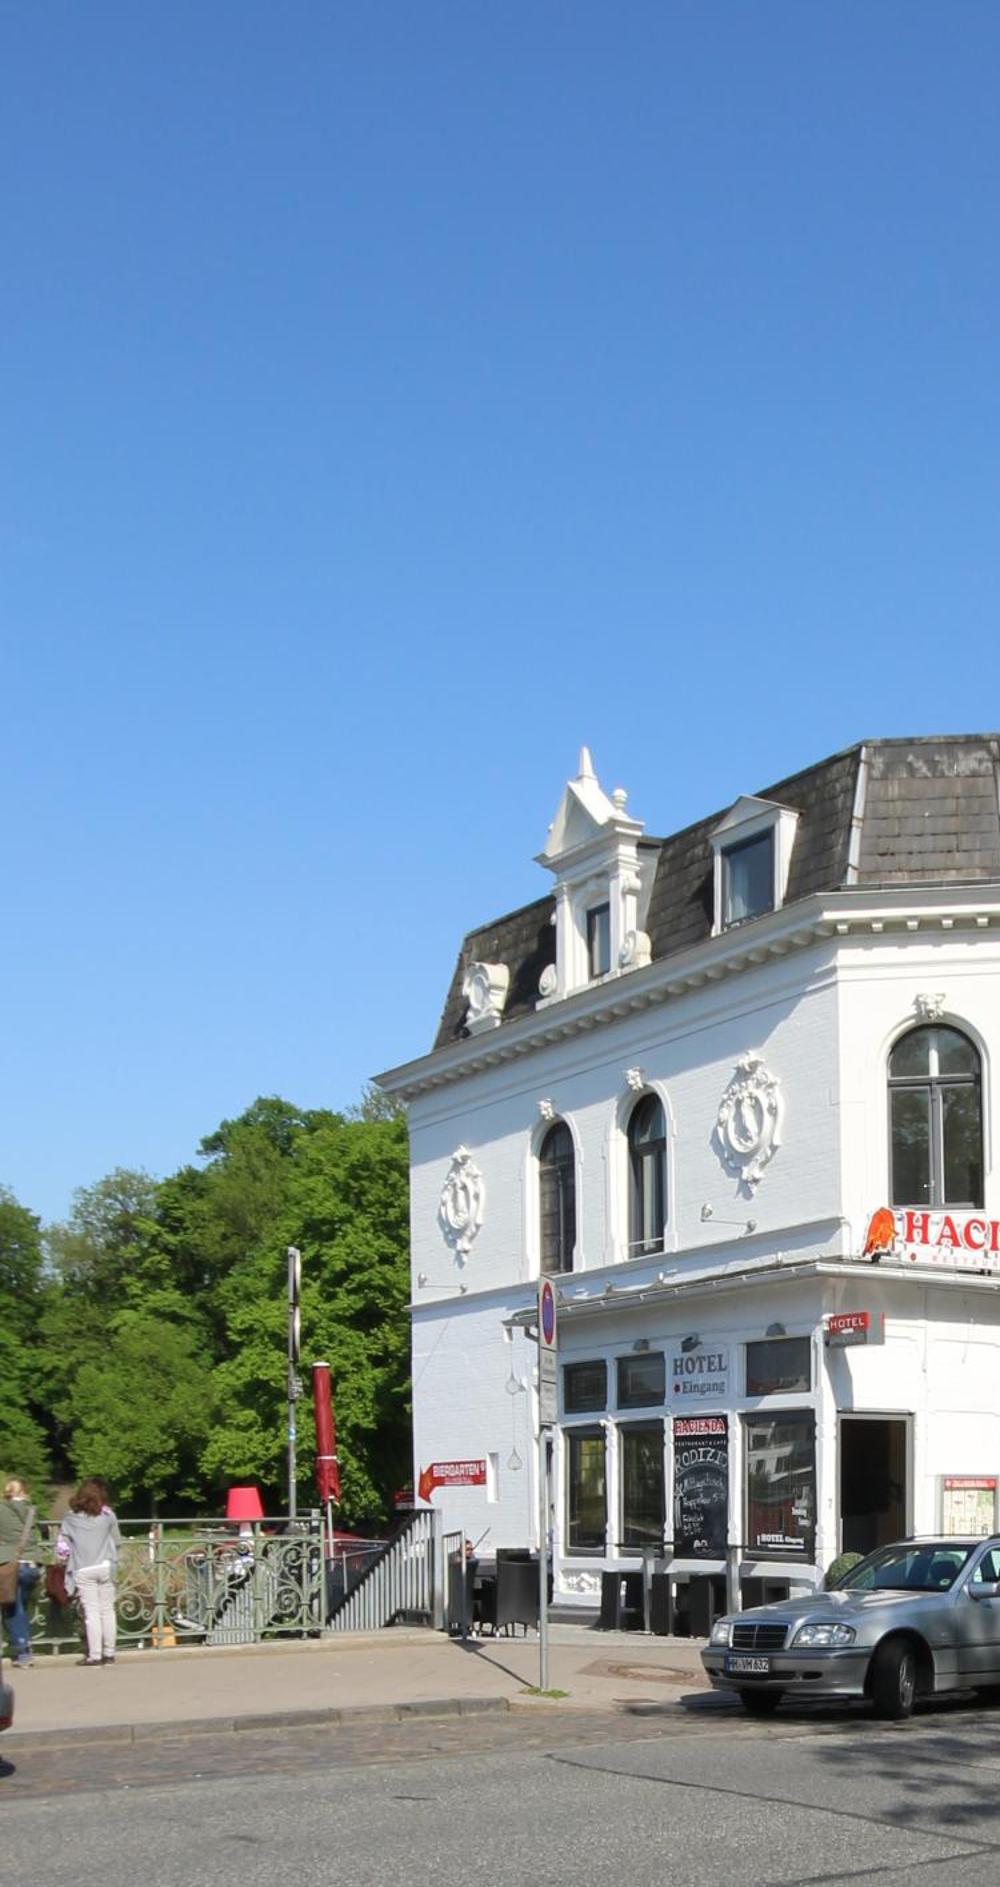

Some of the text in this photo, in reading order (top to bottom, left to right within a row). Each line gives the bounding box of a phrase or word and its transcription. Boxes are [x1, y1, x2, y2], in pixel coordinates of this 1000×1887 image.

[830, 1316, 865, 1329] HOTEL
[672, 1353, 728, 1376] HOTEL
[682, 1380, 726, 1396] Eingang
[674, 1418, 726, 1436] HACIENDA
[432, 1463, 480, 1478] BIERGARTEN
[760, 1534, 784, 1543] HOTEL
